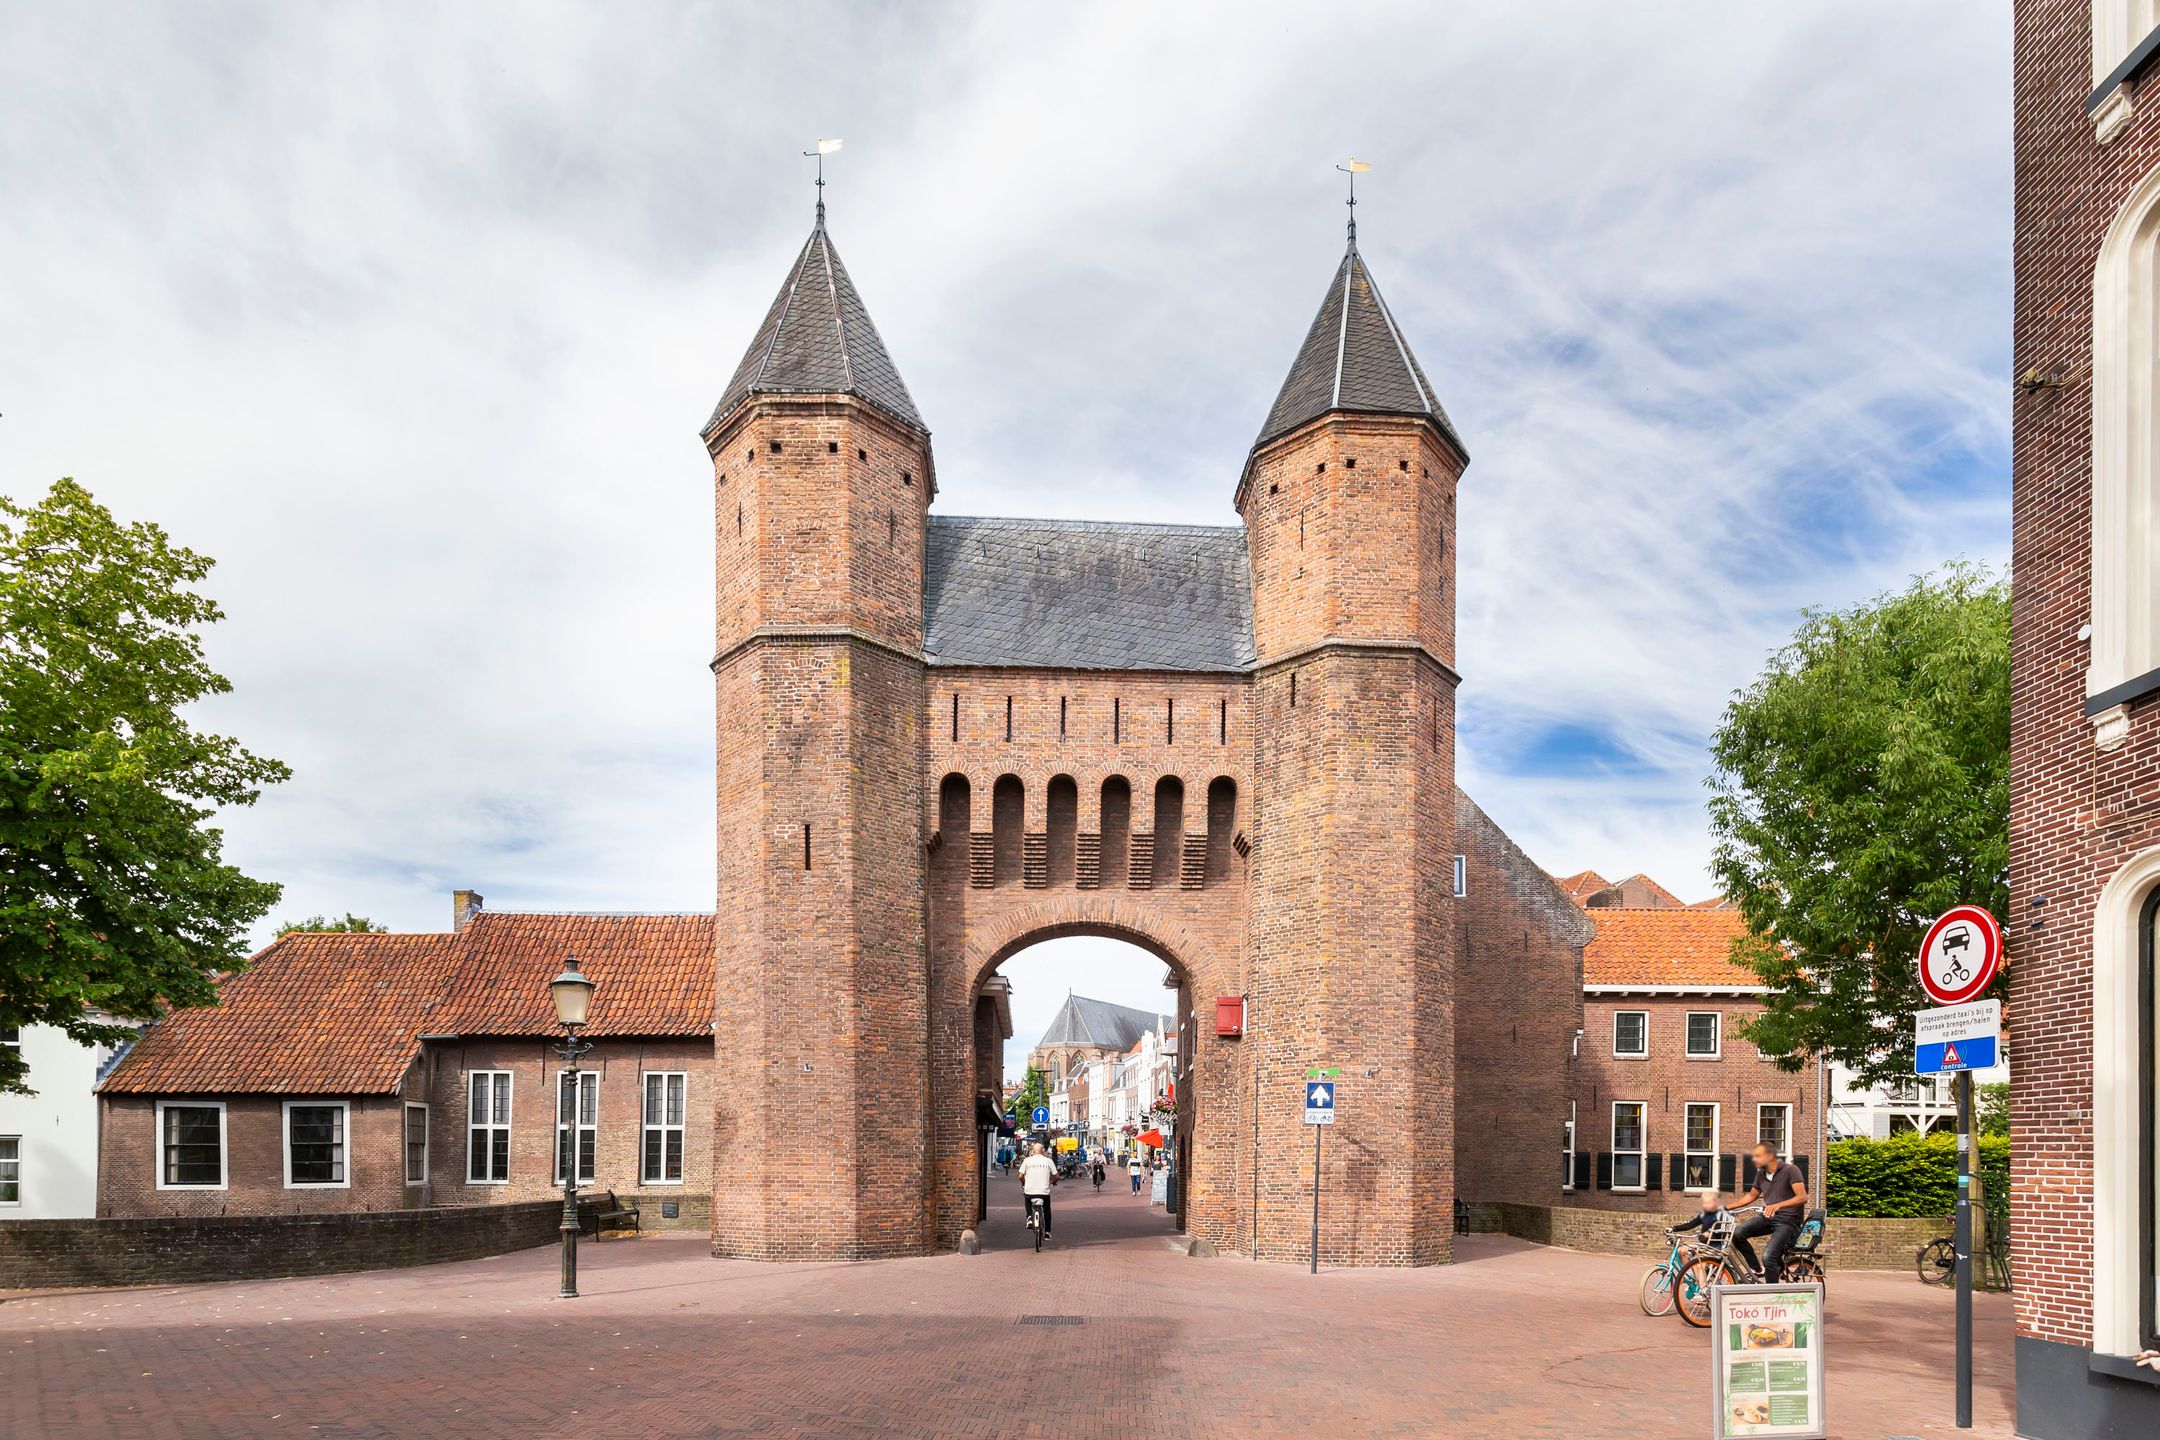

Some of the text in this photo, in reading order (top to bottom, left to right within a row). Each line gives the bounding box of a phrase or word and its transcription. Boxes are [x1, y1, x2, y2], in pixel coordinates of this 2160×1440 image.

[1919, 1012, 1956, 1024] Uitgezonderd
[1976, 1009, 1984, 1017] bij
[1921, 1016, 1991, 1032] afspraak brengen/halen
[1941, 1062, 1967, 1070] controle
[1729, 1306, 1787, 1320] Toko Tjin
